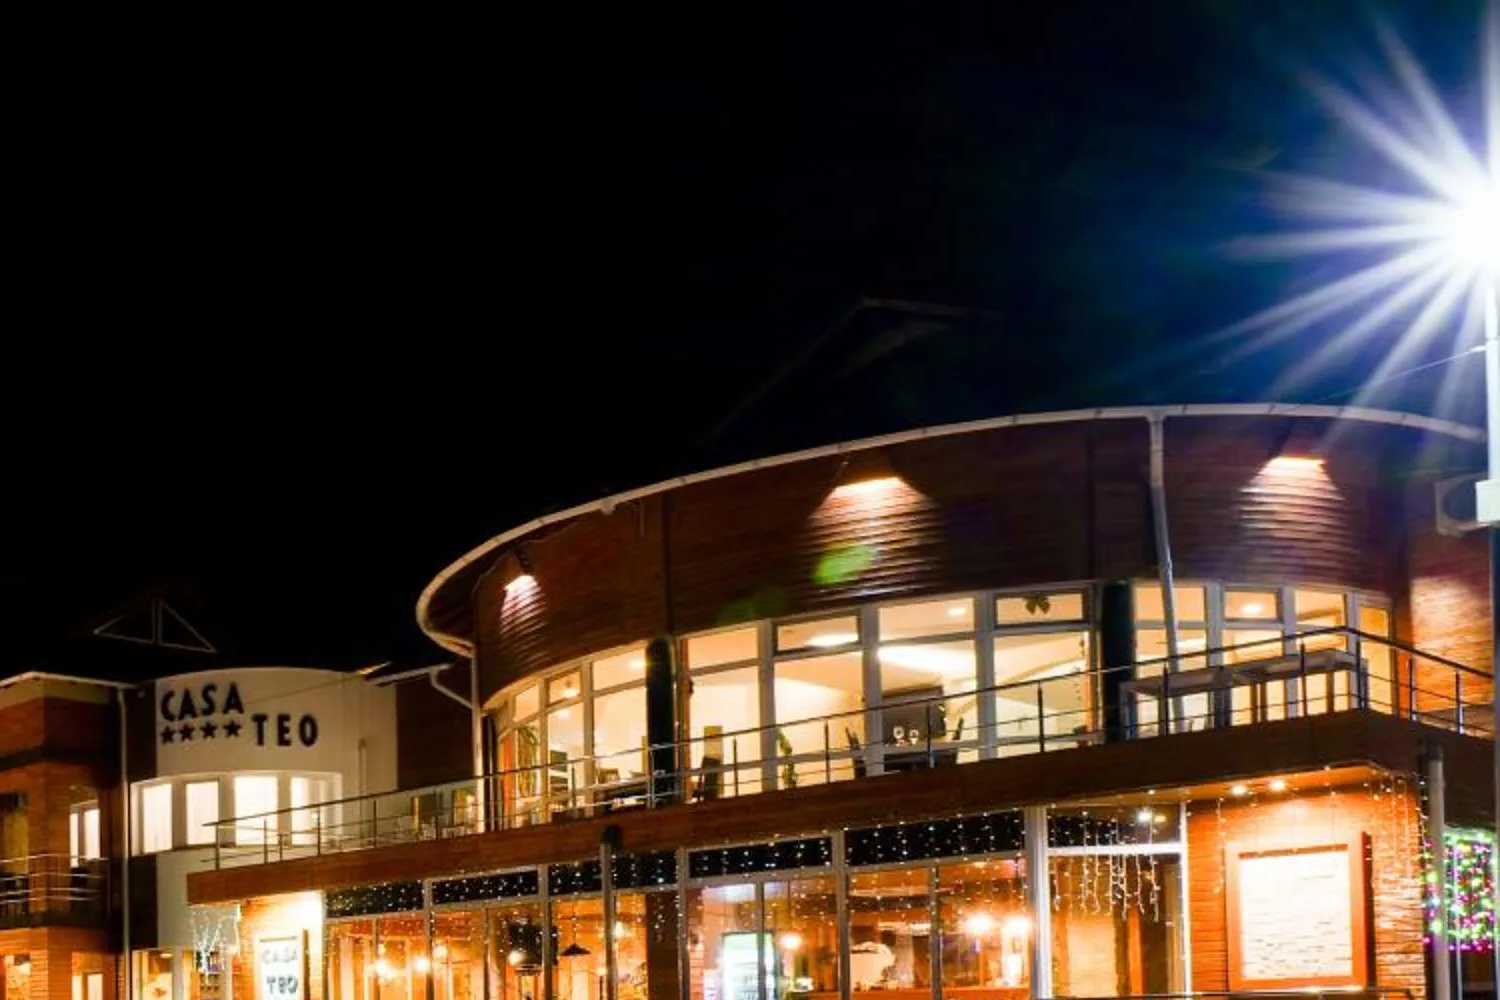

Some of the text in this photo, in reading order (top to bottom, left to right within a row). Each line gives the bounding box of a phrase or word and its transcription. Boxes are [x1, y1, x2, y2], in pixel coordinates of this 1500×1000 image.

[160, 681, 244, 723] CASA
[250, 714, 318, 747] TEO
[266, 974, 299, 995] TEO
